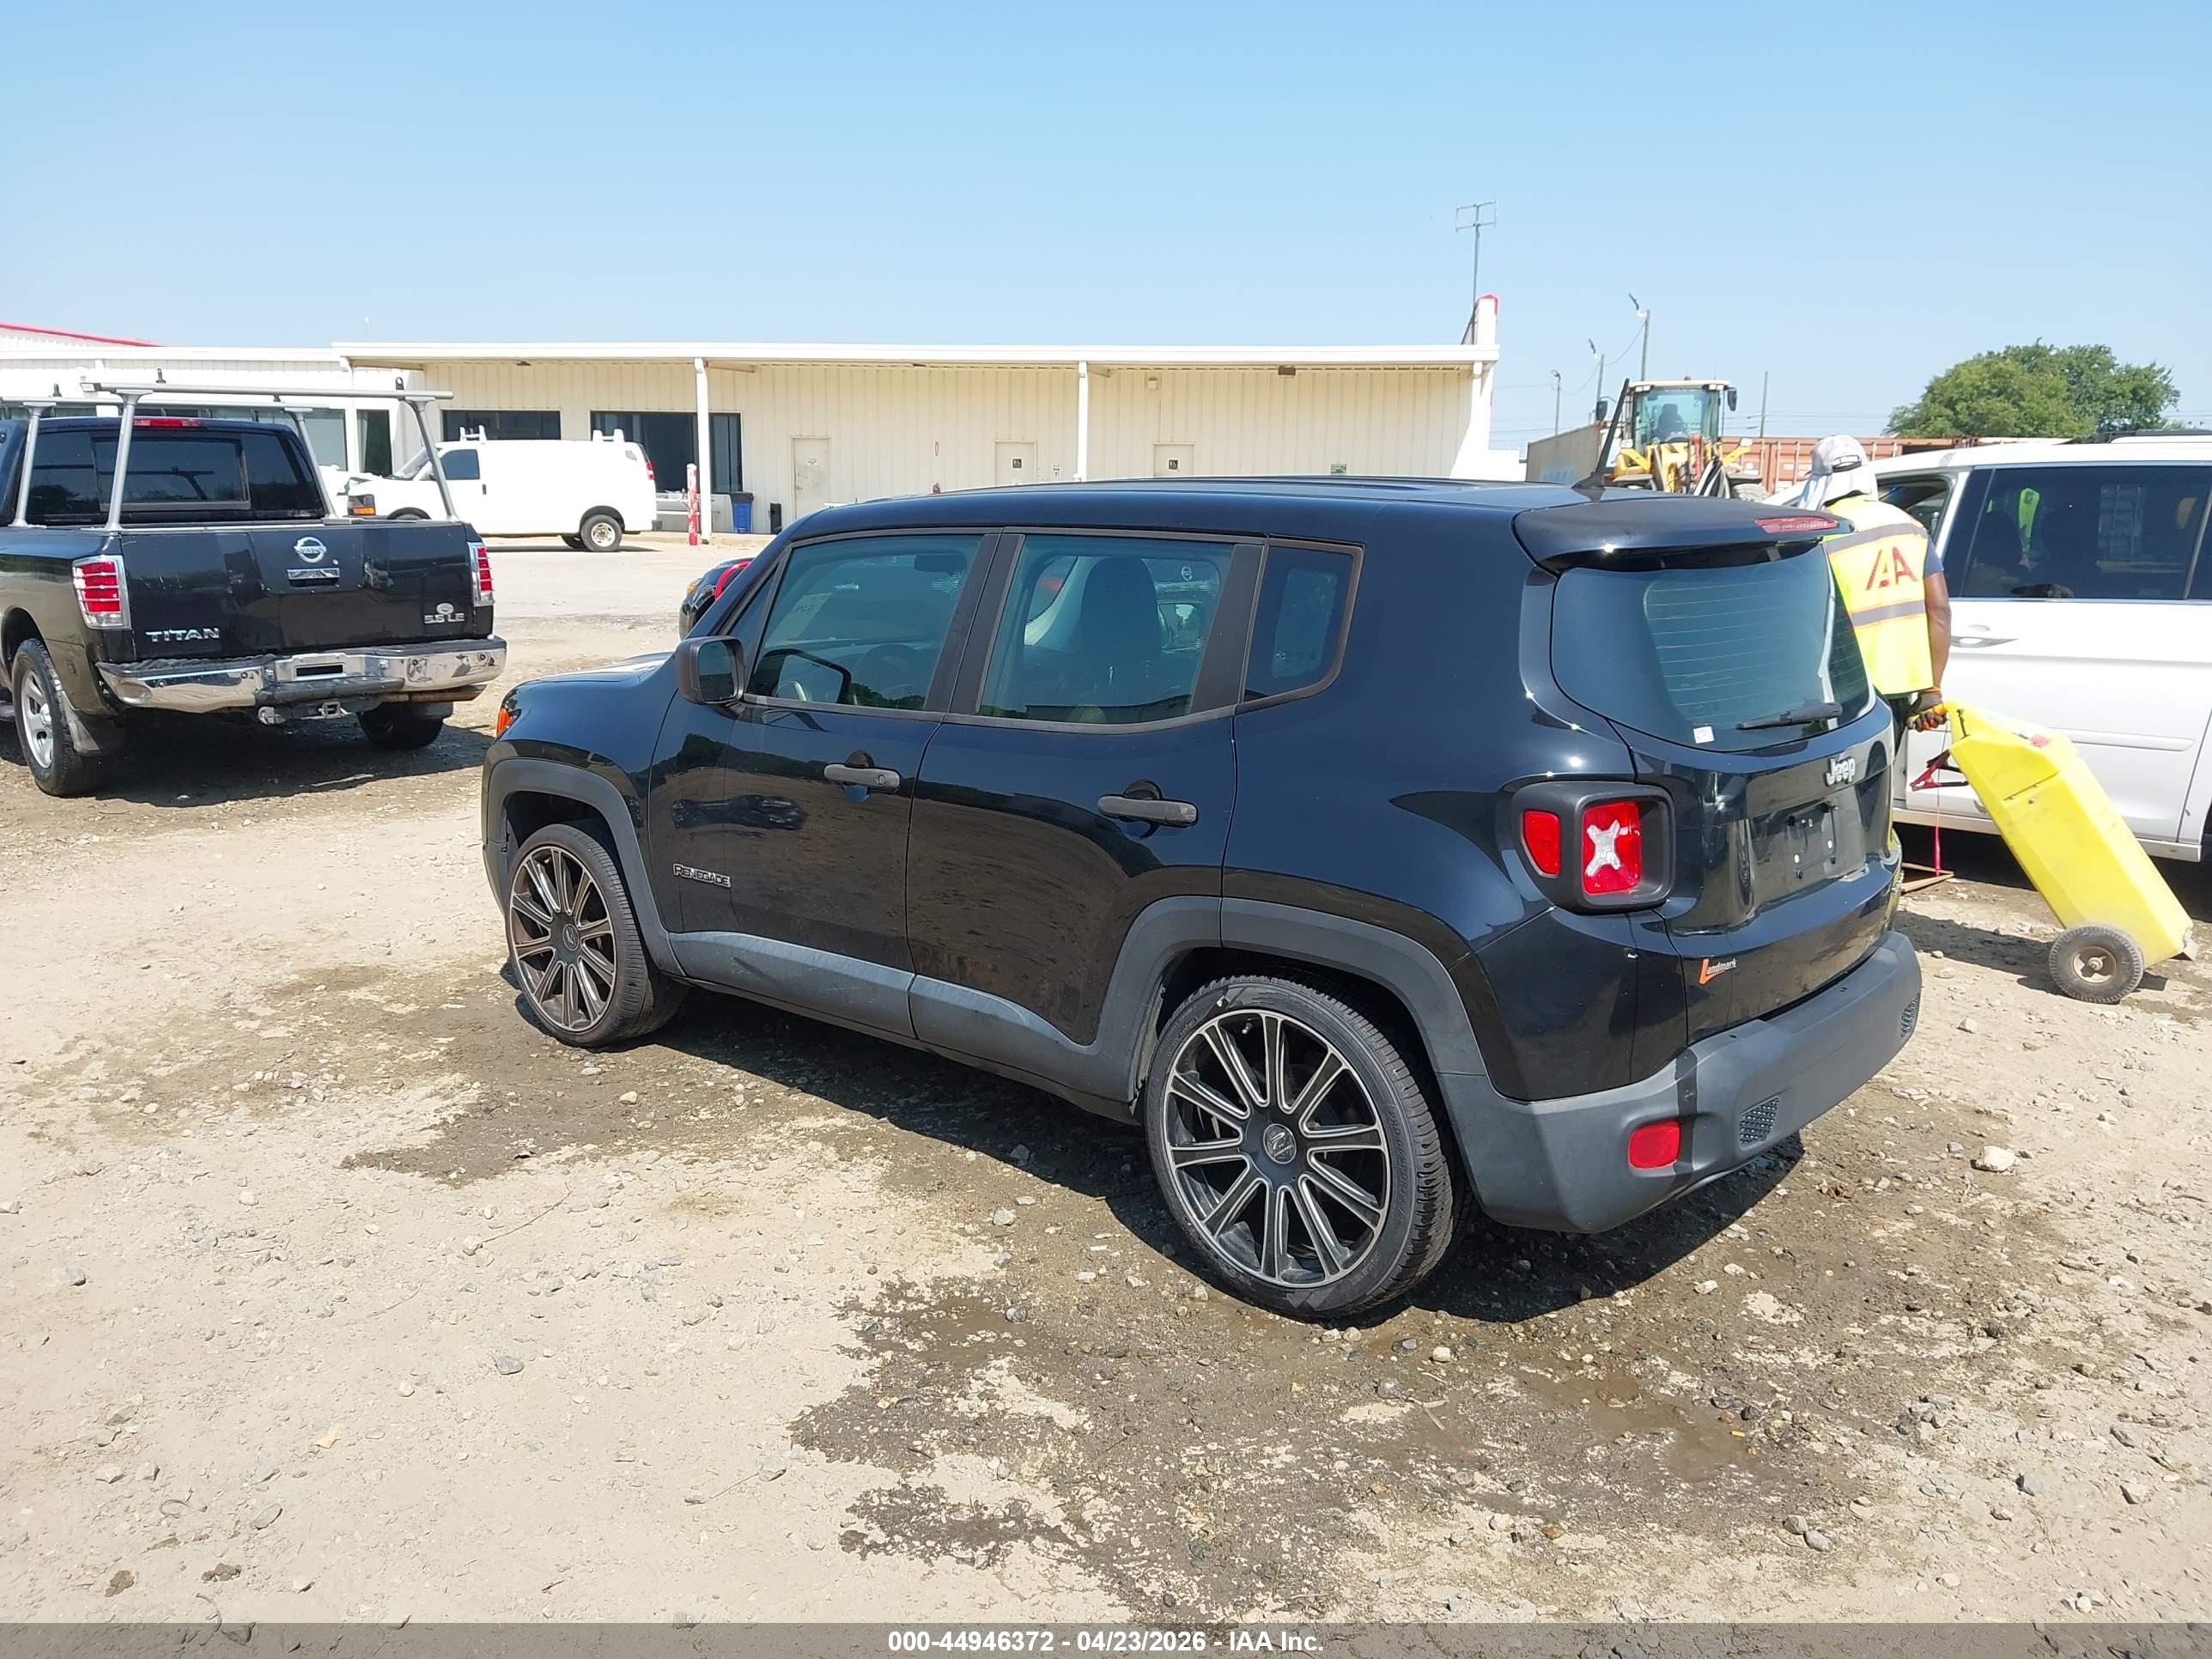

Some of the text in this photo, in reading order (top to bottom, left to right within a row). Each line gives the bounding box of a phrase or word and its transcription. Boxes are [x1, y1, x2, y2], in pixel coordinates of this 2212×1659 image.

[447, 612, 465, 622] LE
[145, 627, 220, 642] TITAN
[1826, 758, 1855, 785] Jeep
[1699, 957, 1737, 984] Landmark
